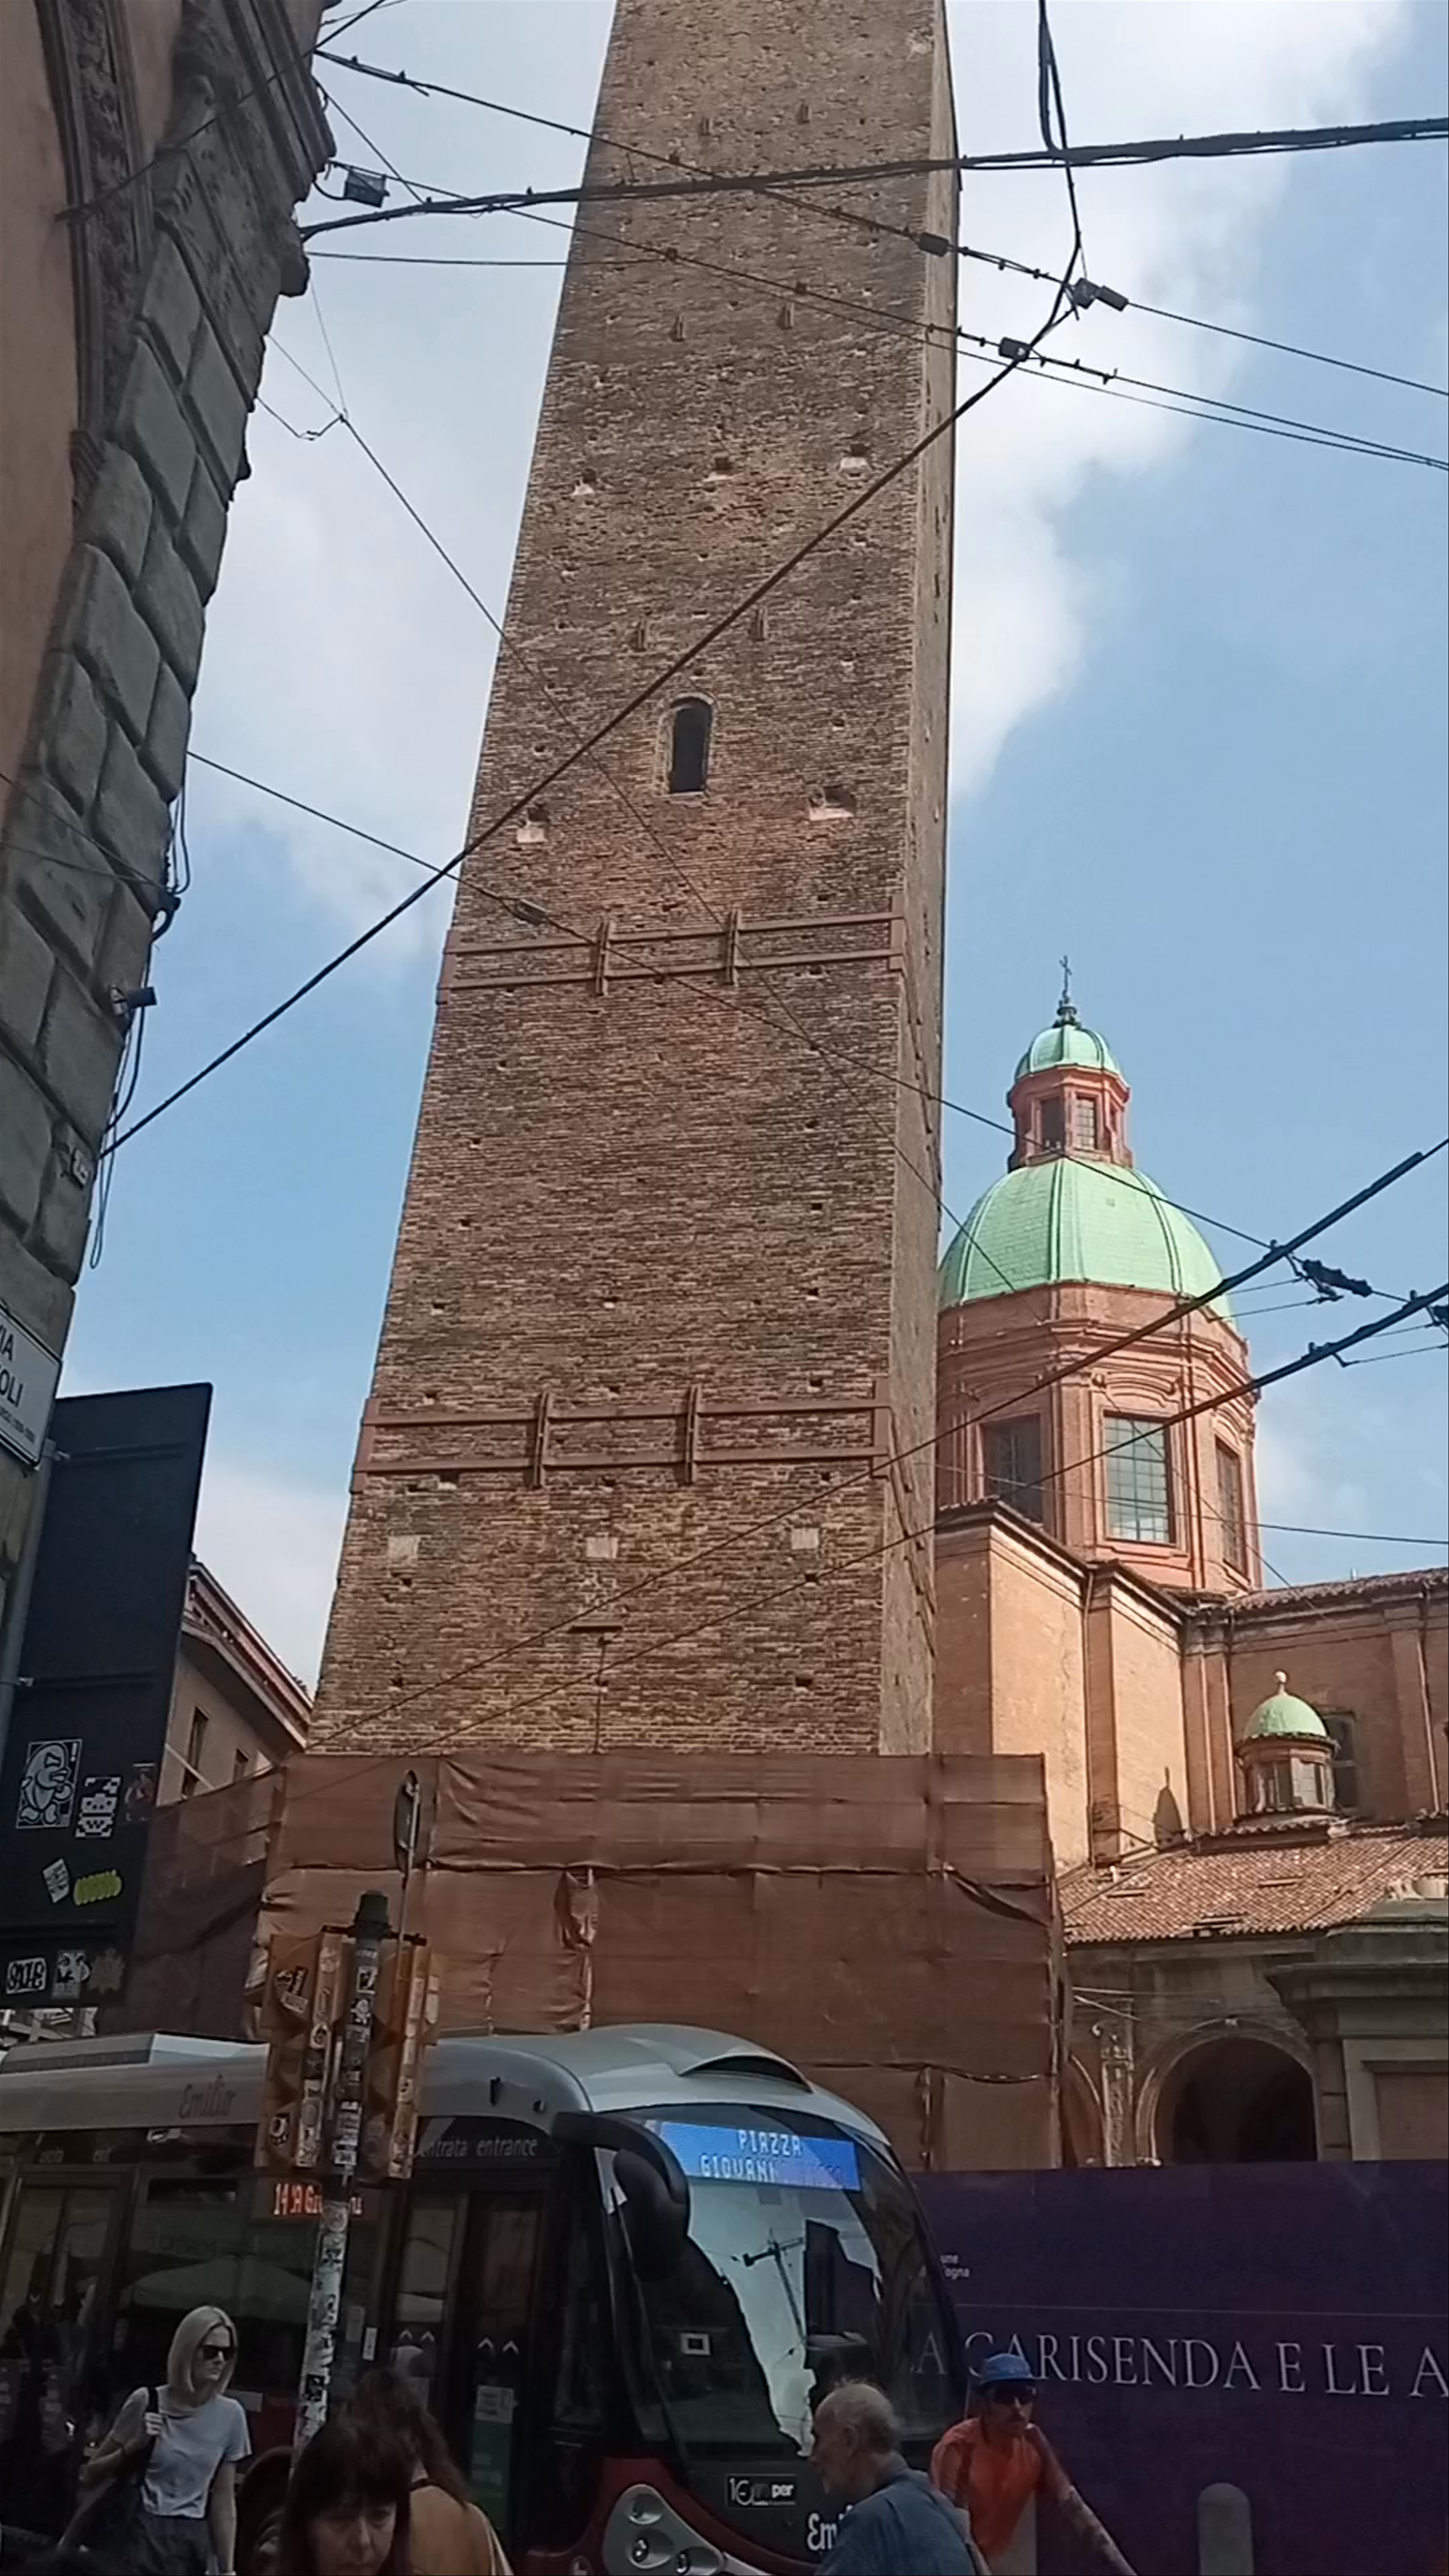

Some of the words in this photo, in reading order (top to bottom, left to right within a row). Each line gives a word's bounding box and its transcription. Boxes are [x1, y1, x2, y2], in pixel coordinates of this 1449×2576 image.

[0, 1365, 23, 1407] OLI
[476, 2135, 538, 2156] entrance
[739, 2129, 802, 2156] PIAZZA
[1275, 2342, 1306, 2392] E
[1321, 2343, 1390, 2395] LE
